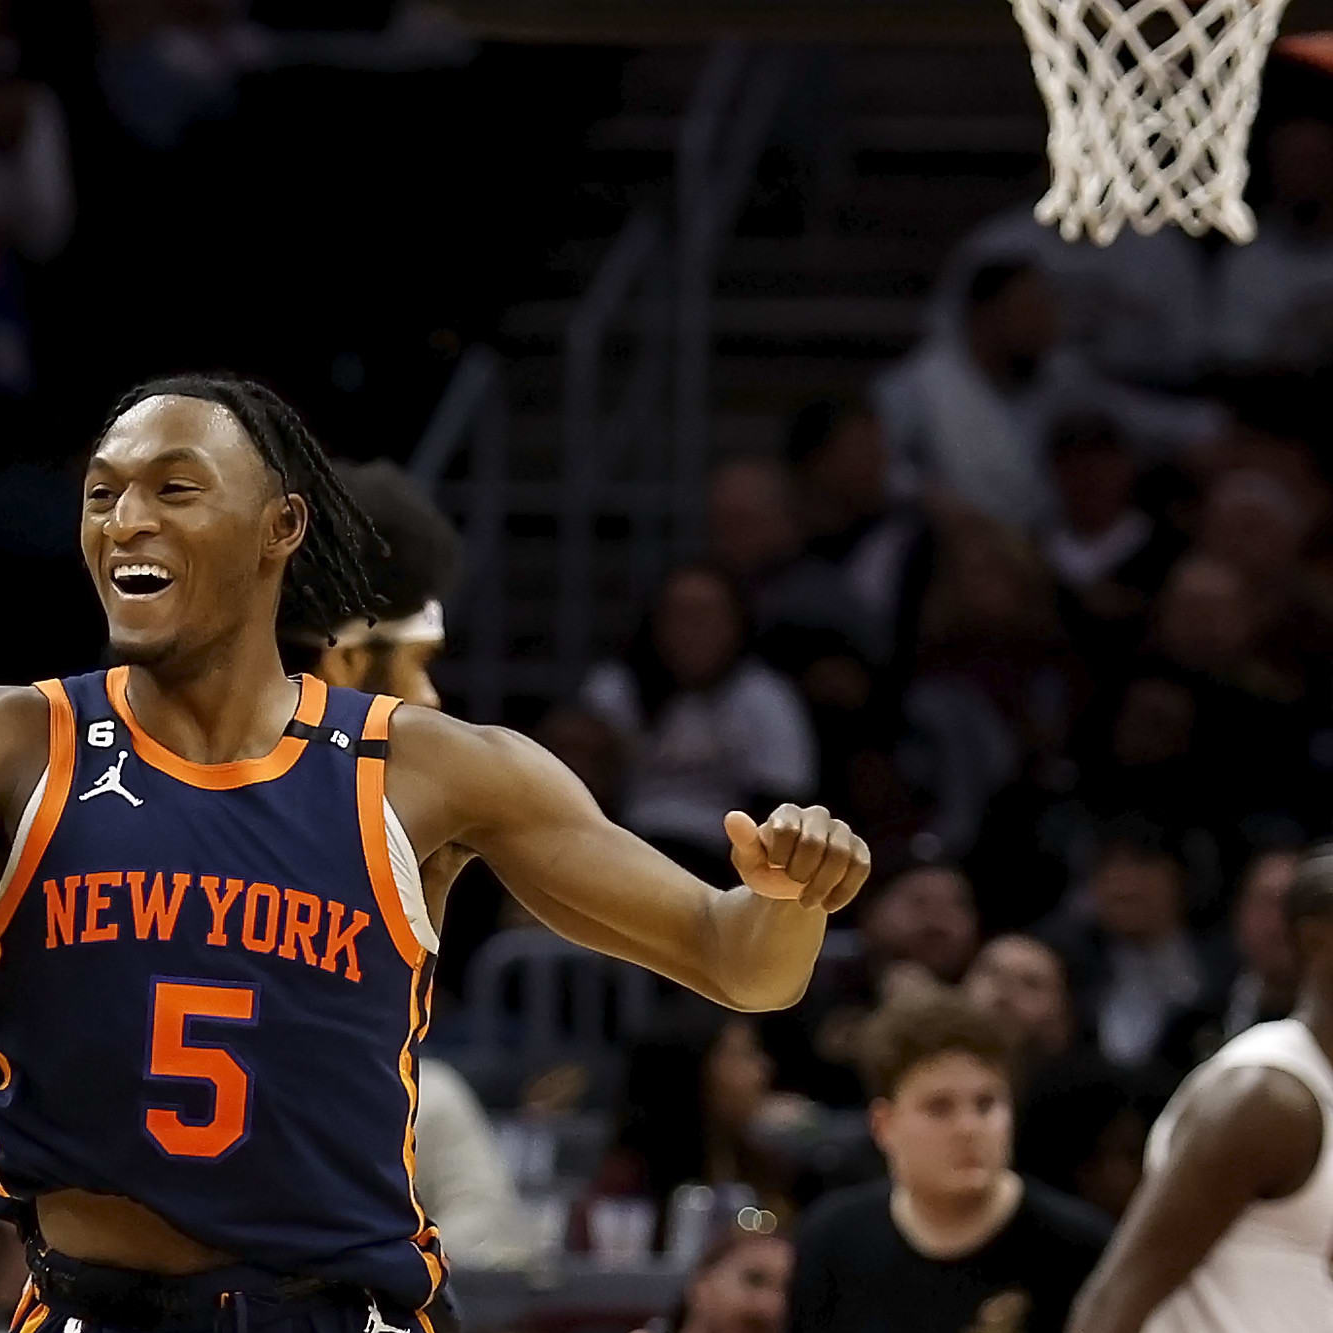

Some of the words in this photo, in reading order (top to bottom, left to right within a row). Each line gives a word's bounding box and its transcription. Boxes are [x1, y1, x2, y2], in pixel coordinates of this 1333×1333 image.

[87, 719, 115, 748] 6
[329, 729, 350, 749] 19
[42, 871, 193, 950] NEW
[199, 875, 371, 984] YORK
[144, 978, 257, 1160] 5
